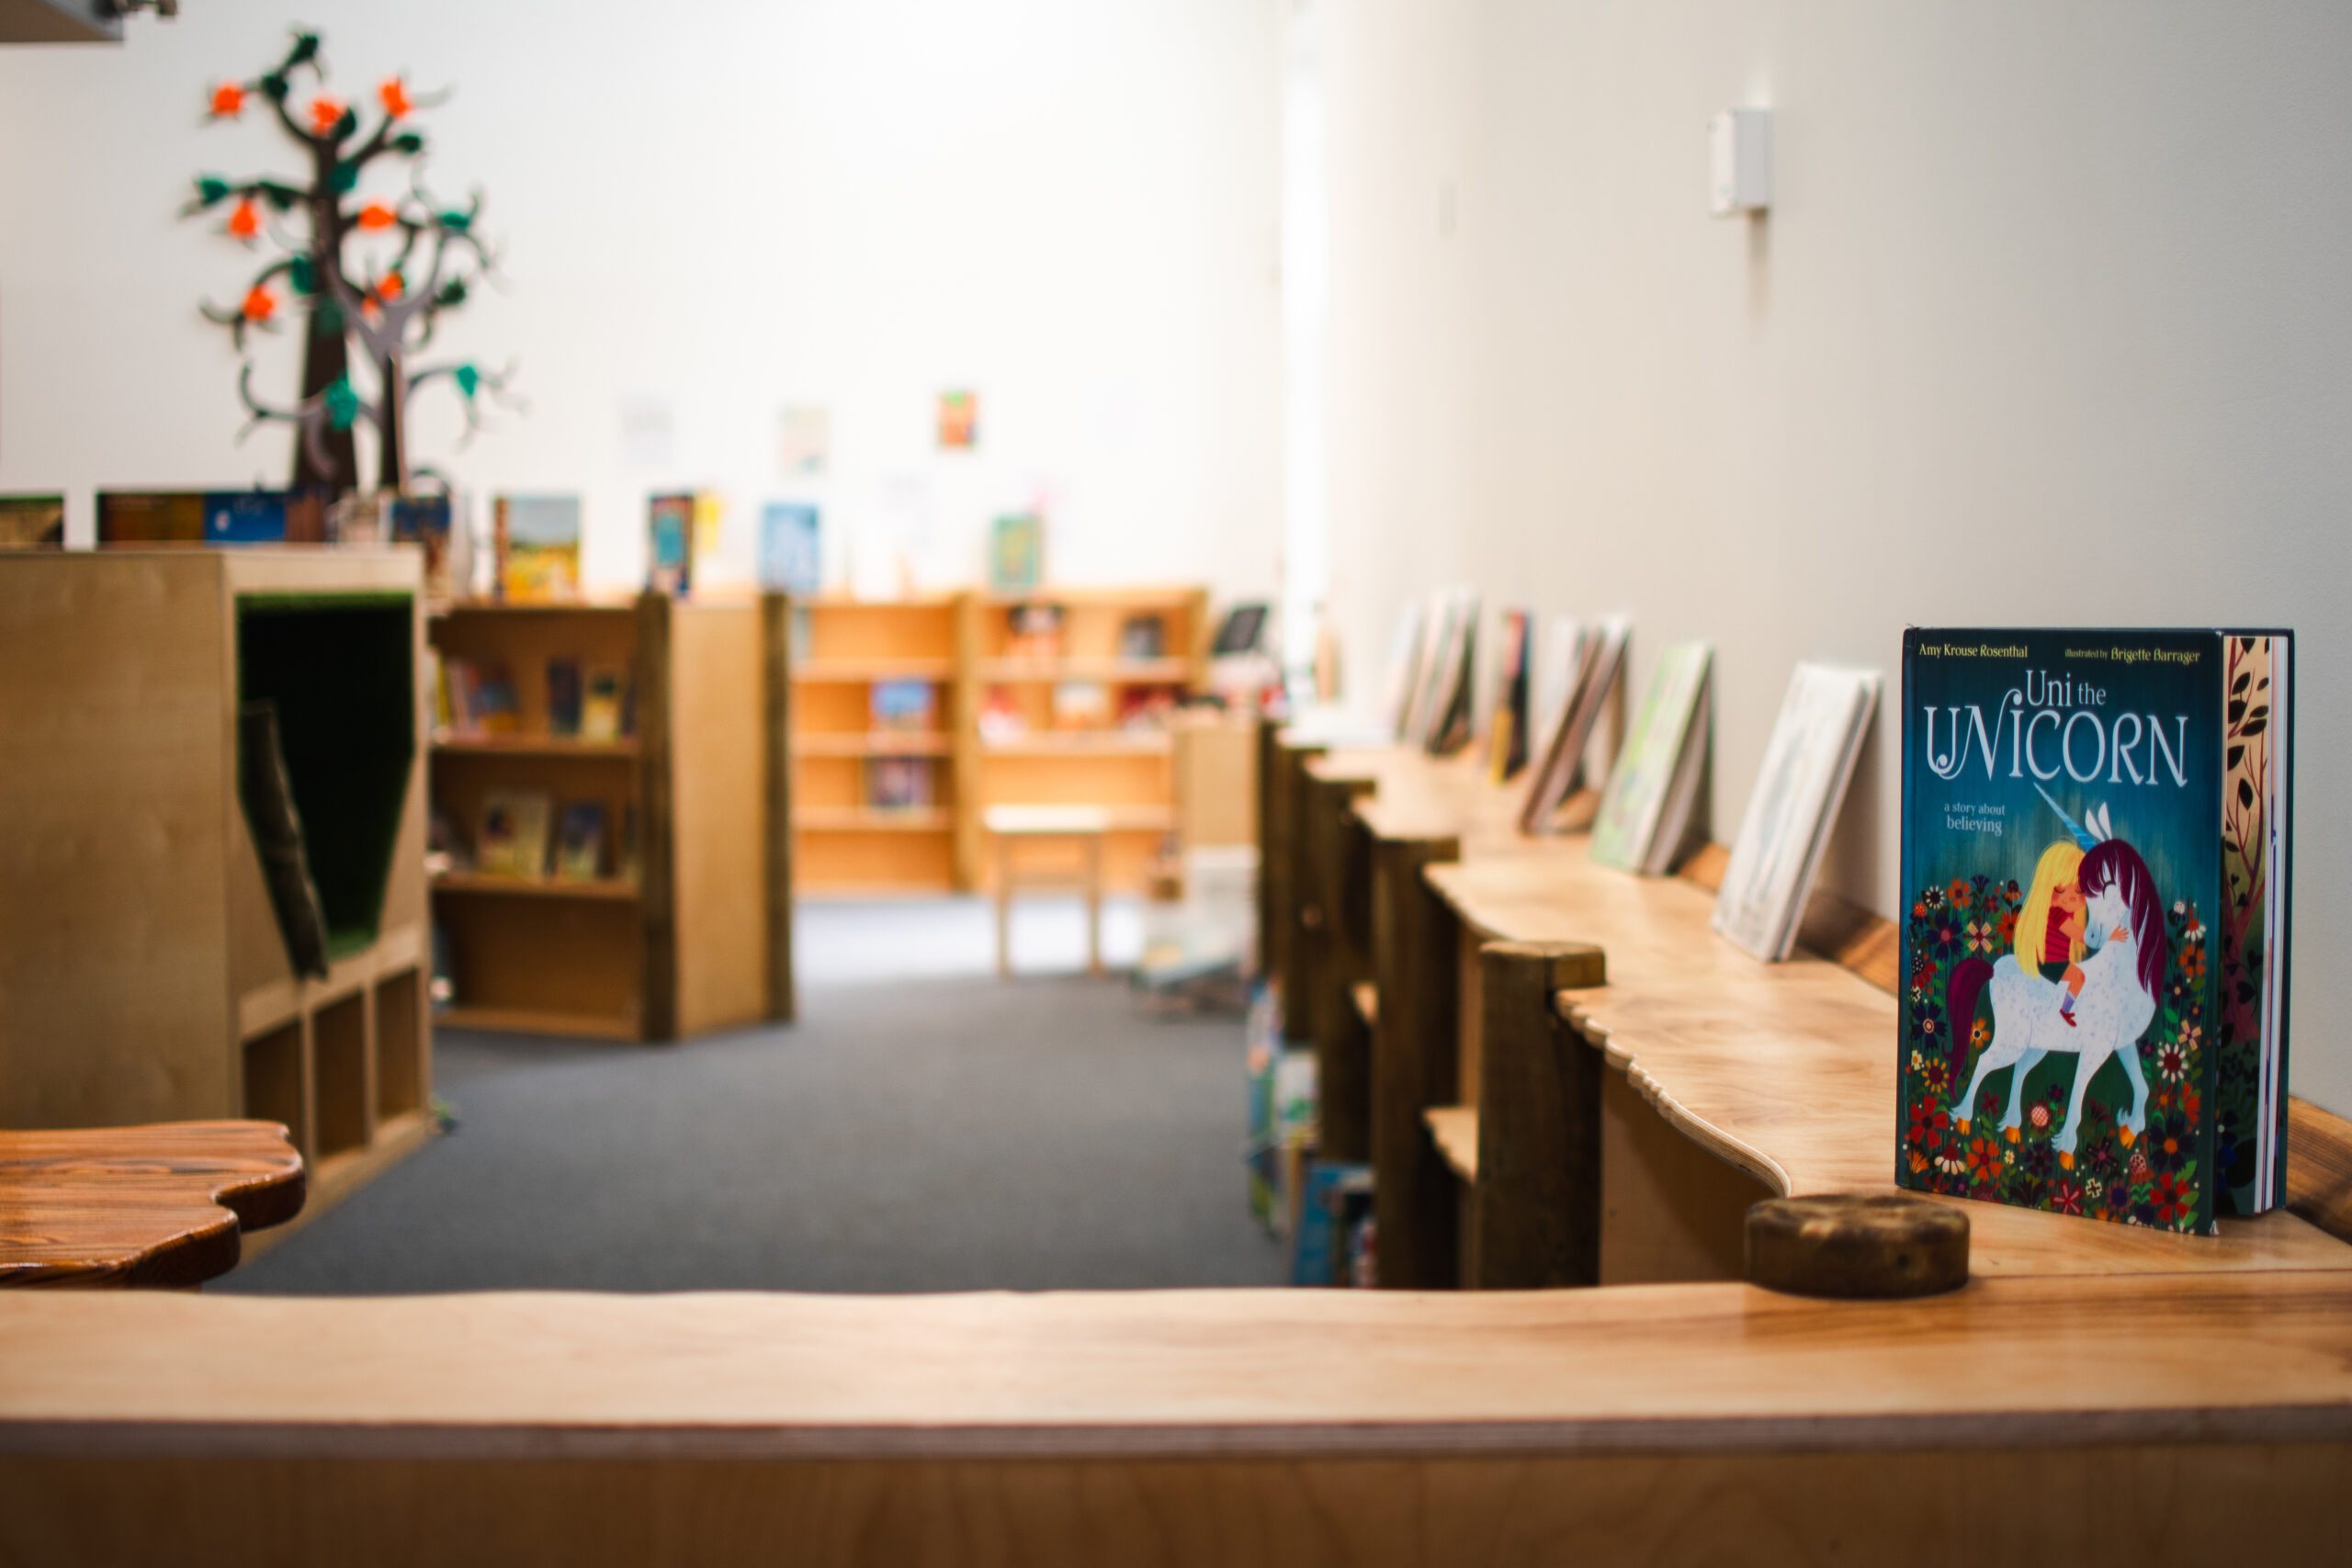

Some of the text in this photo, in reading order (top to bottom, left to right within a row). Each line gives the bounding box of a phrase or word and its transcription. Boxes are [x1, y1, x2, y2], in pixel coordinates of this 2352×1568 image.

[1919, 643, 2028, 659] Amy Krouse Rosenthal
[2064, 647, 2201, 666] illustrated by Brigette Barrager
[2025, 670, 2107, 707] Uni the
[1943, 802, 2006, 816] a story about
[1947, 814, 2003, 837] believing
